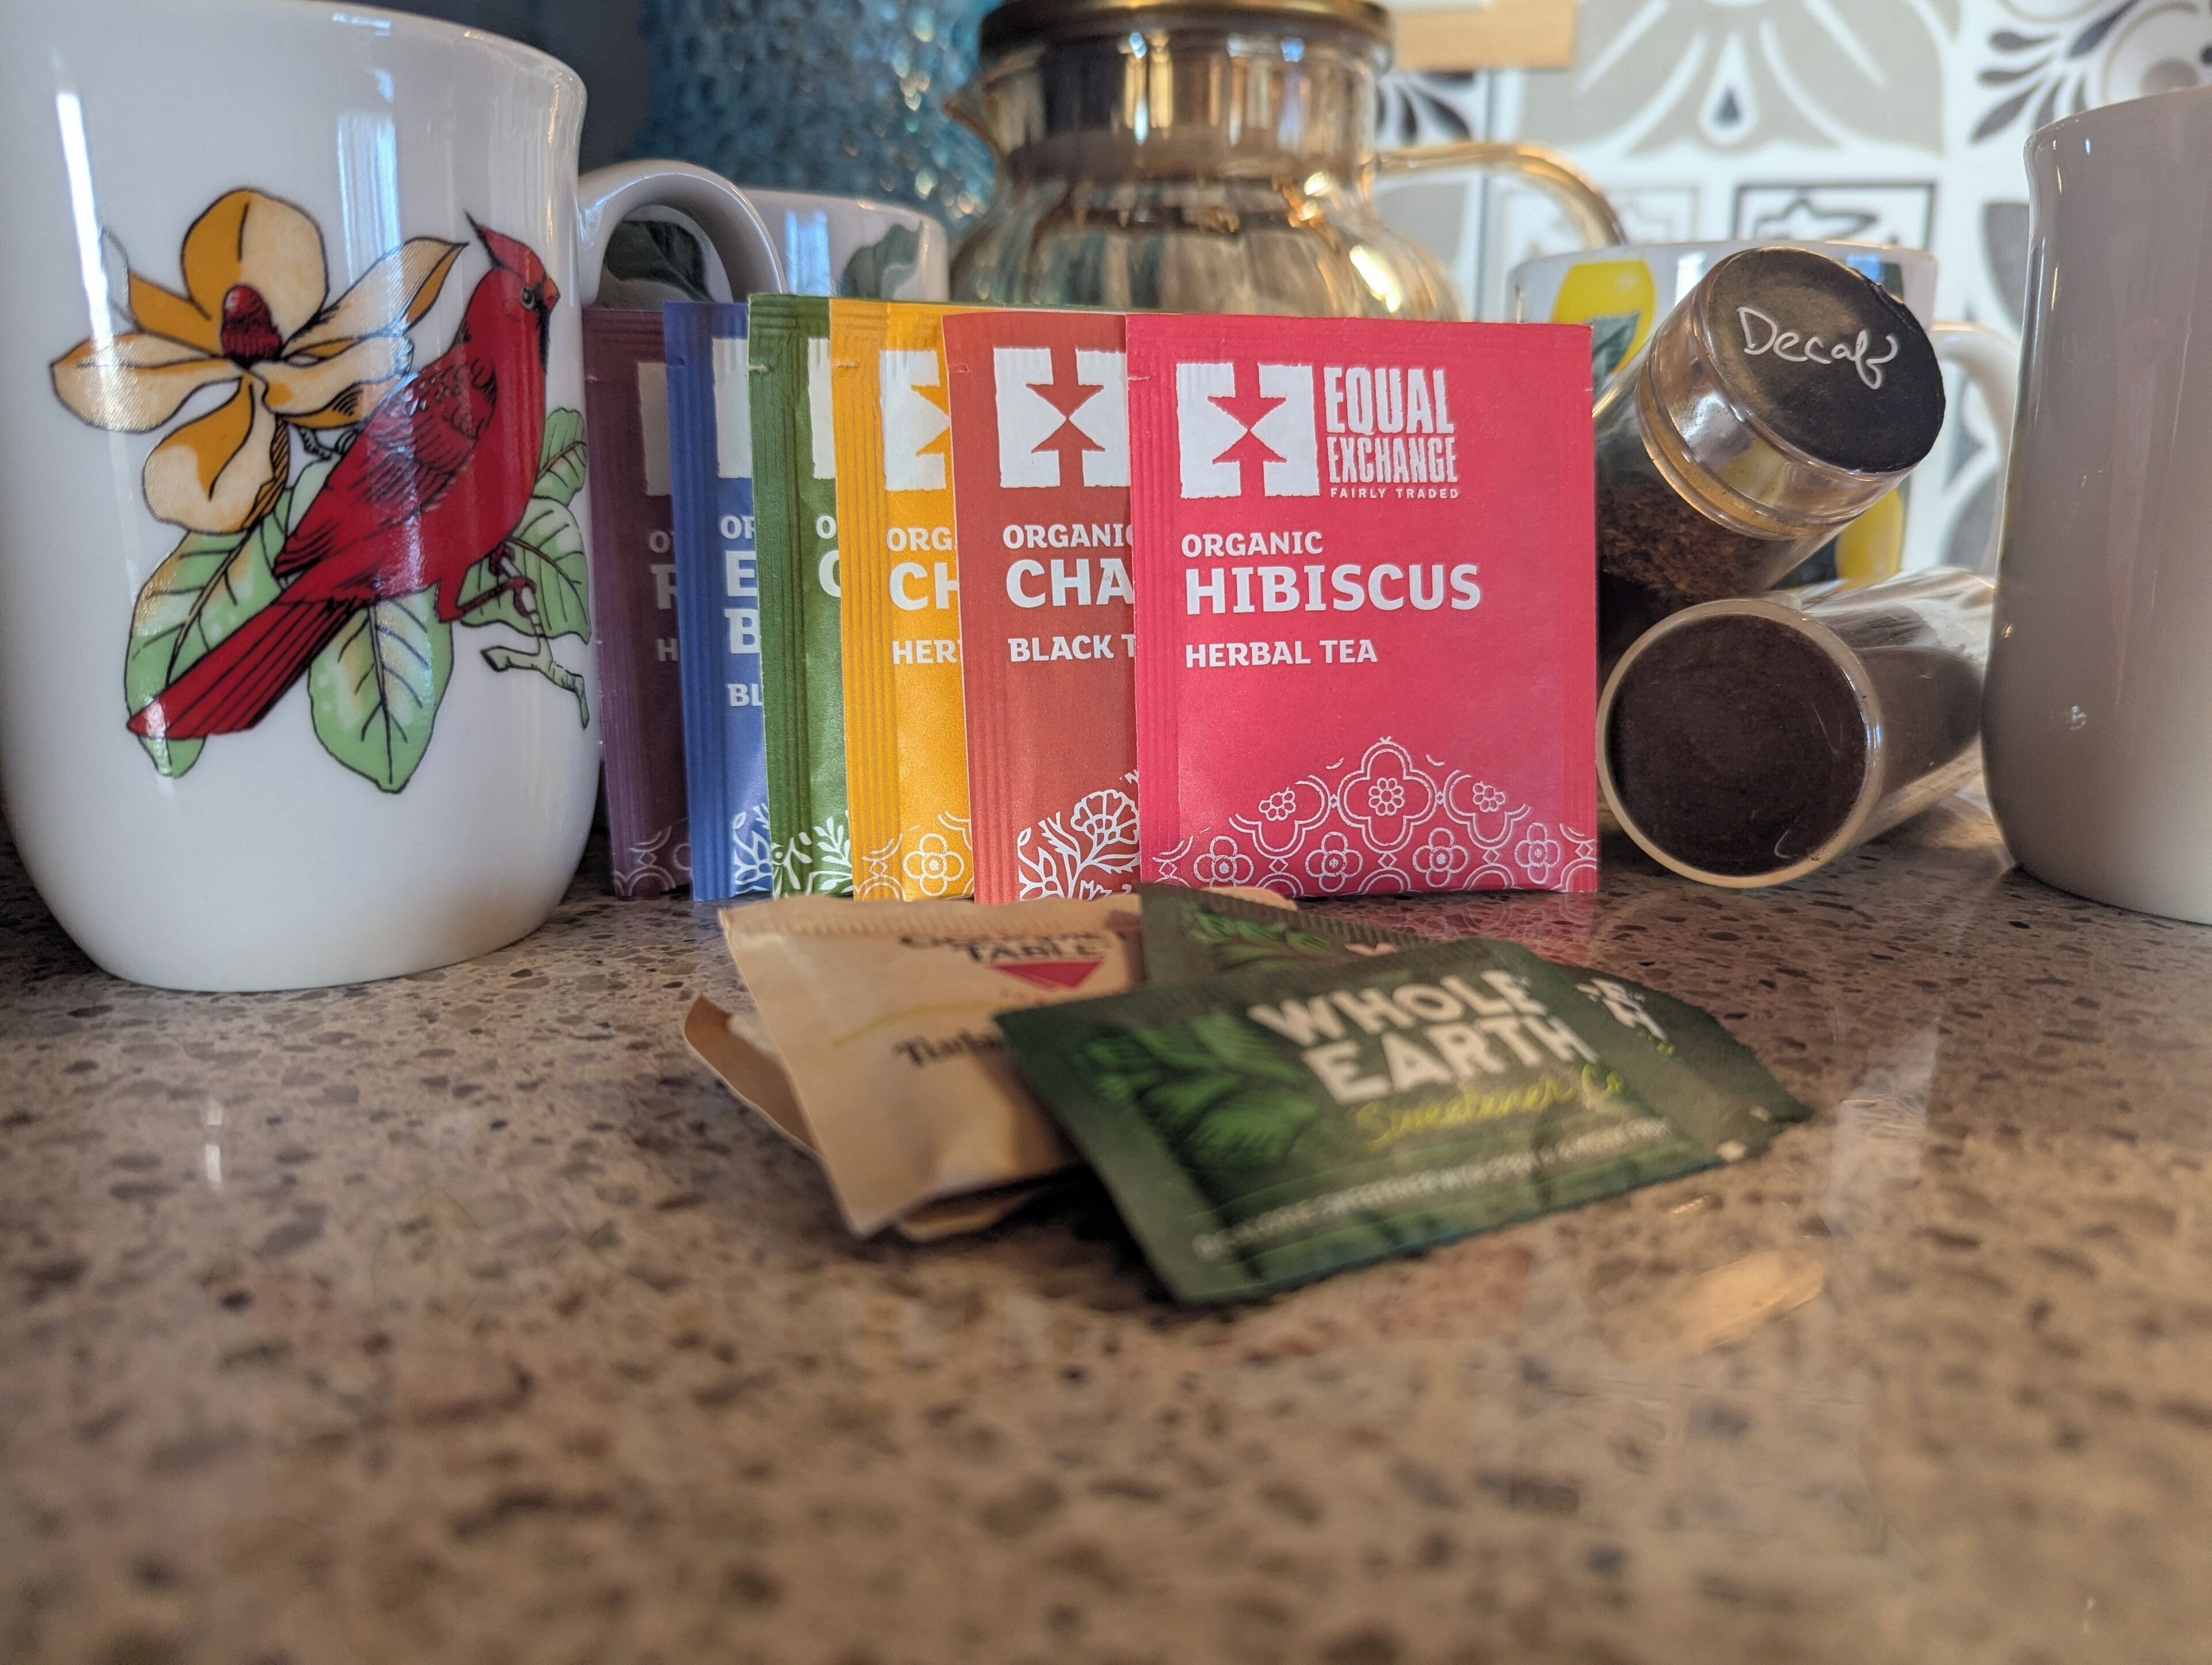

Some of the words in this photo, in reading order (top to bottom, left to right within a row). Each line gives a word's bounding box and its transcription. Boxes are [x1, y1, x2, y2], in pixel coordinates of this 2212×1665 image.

[1737, 306, 1898, 390] Decaf
[1323, 367, 1454, 435] EQUAL
[1327, 437, 1457, 483] EXCHANGE
[1330, 488, 1386, 499] FAIRLY
[1395, 488, 1459, 499] TRADED
[887, 527, 957, 551] ORG
[1181, 531, 1323, 557] ORGANIC
[725, 551, 758, 597] E
[889, 562, 960, 611] CH
[1006, 557, 1134, 608] CHA
[1185, 564, 1481, 615] HIBISCUS
[725, 608, 760, 654] B
[892, 639, 962, 665] HER
[1007, 635, 1115, 662] BLACK
[1185, 640, 1311, 669] HERBAL
[1319, 639, 1378, 664] TEA
[1245, 969, 1548, 1046] WHOLE
[1301, 1015, 1601, 1105] EARTH
